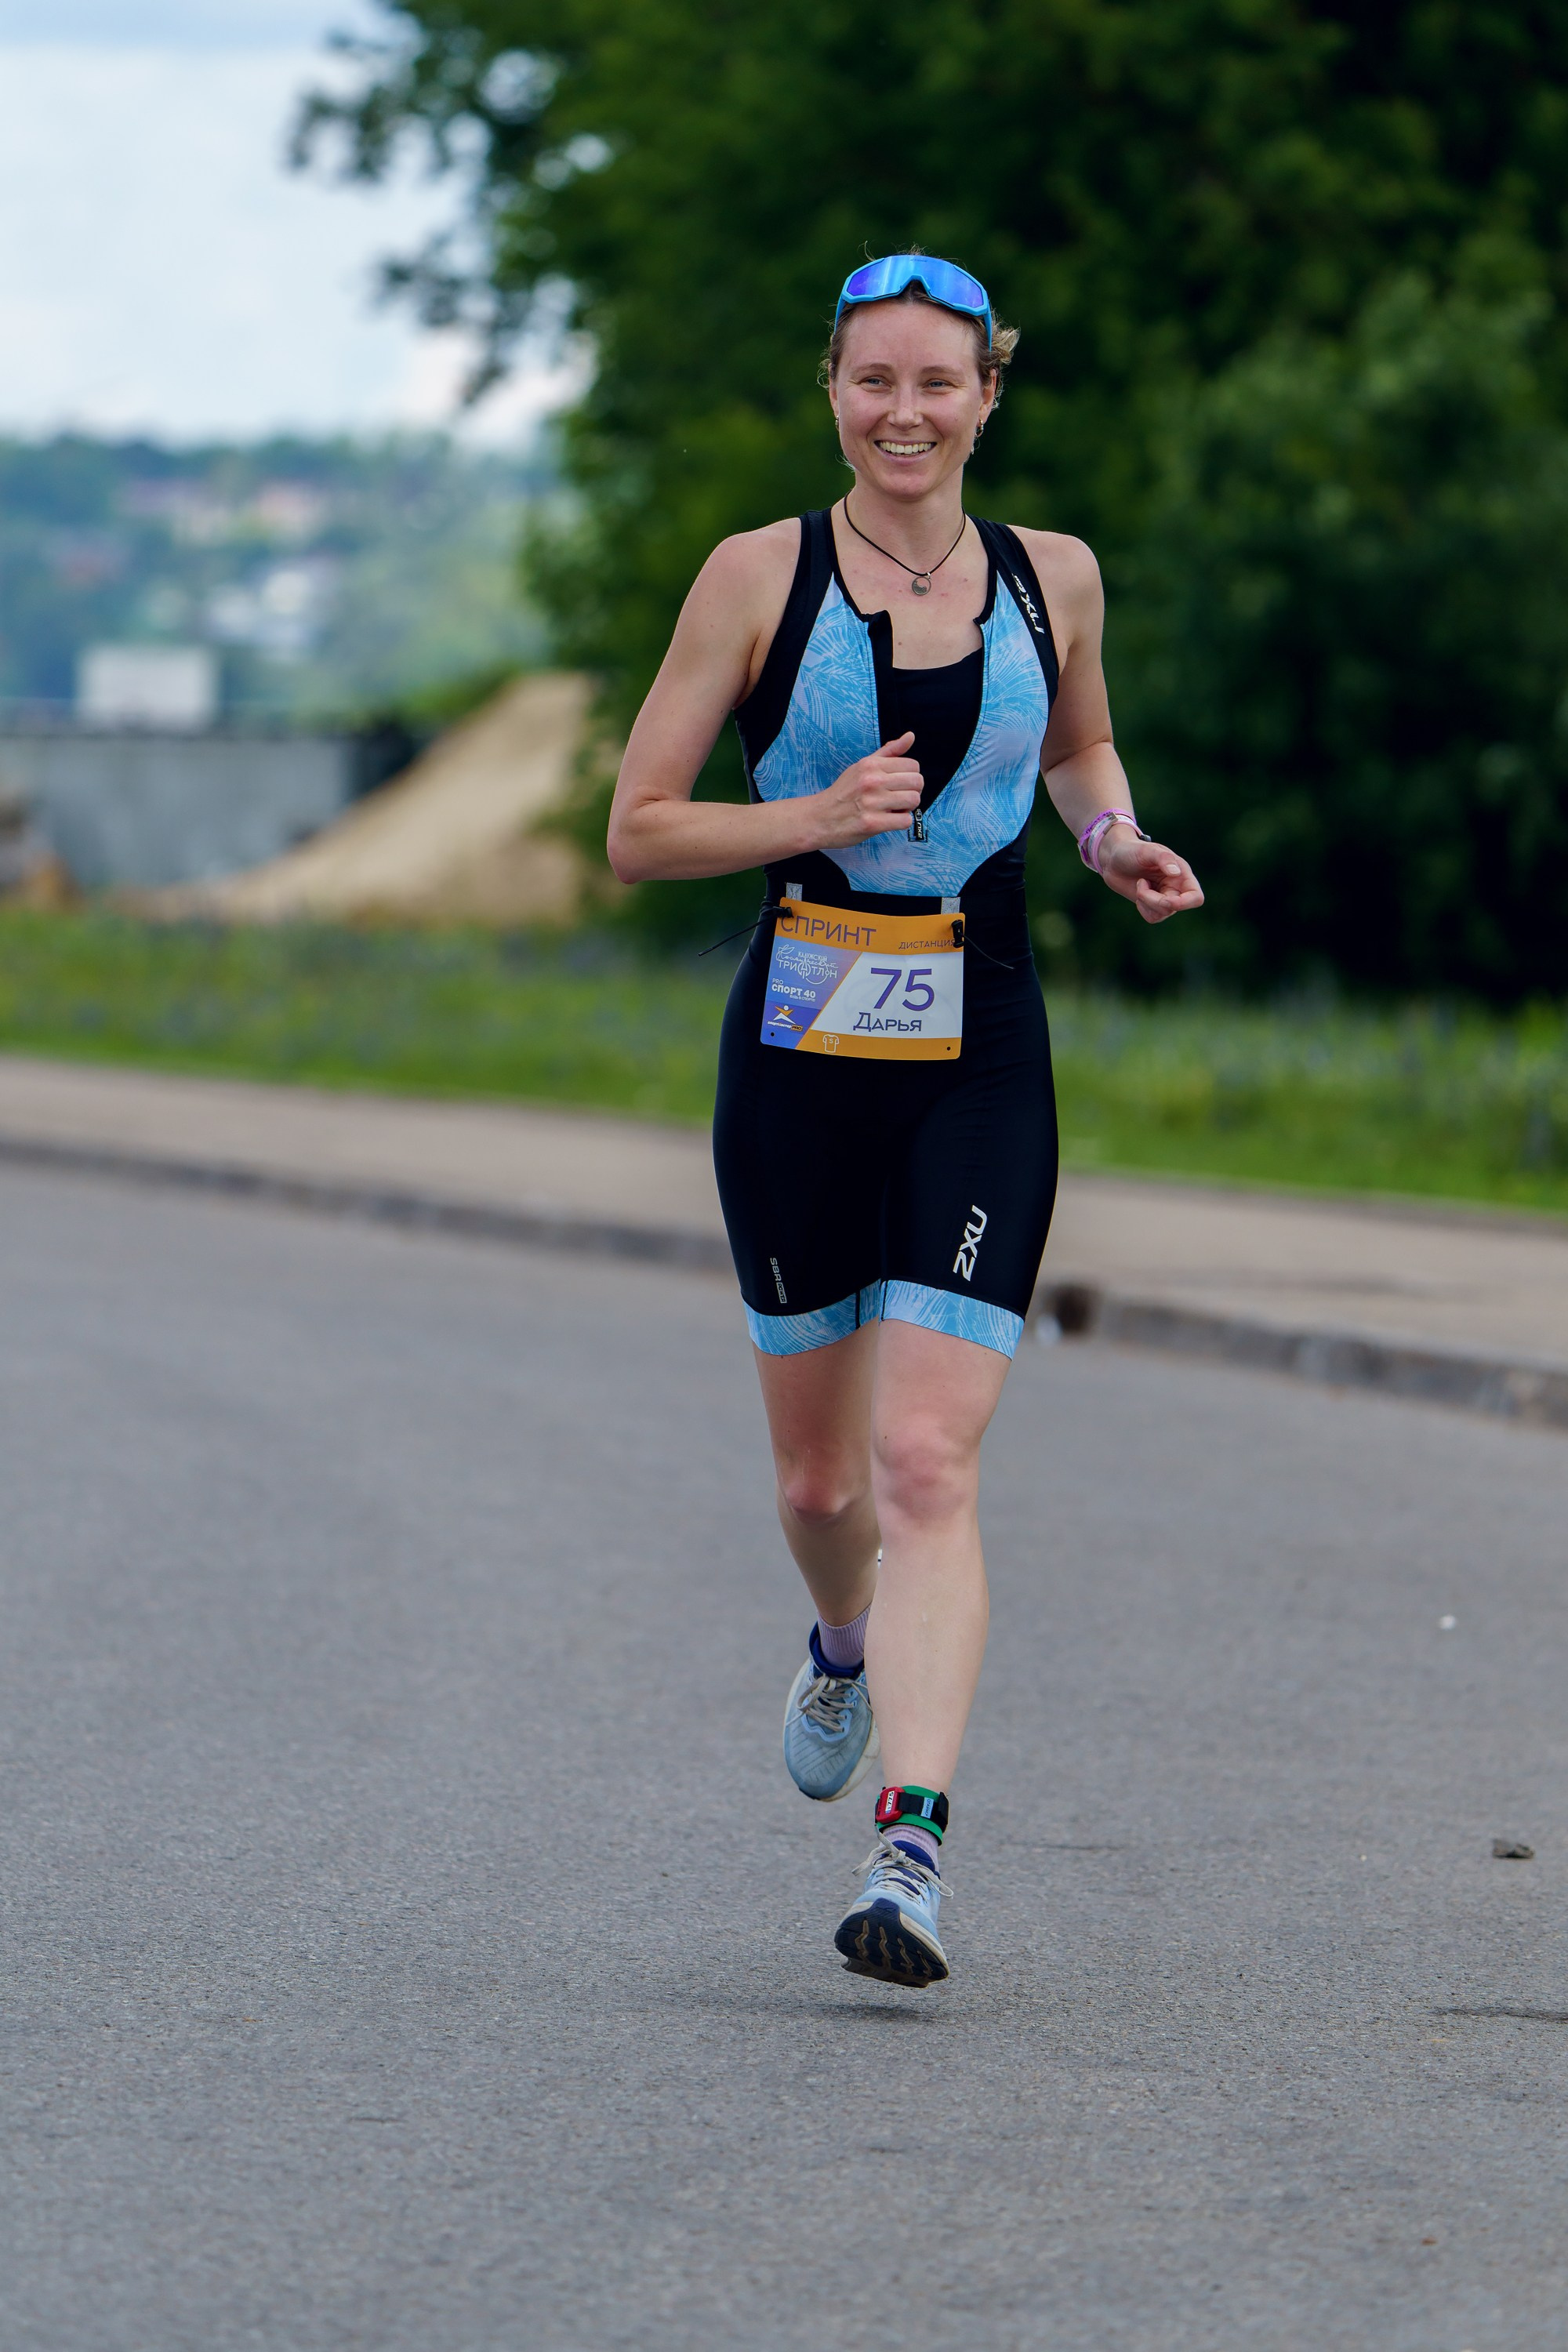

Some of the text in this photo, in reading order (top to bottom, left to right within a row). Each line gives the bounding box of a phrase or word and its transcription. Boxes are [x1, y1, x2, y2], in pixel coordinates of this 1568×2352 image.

[781, 915, 877, 946] СПРИНТ
[771, 984, 816, 998] СПОРТ 40
[870, 967, 935, 1011] 75
[953, 1204, 987, 1282] 2XU
[770, 1258, 782, 1281] SBR
